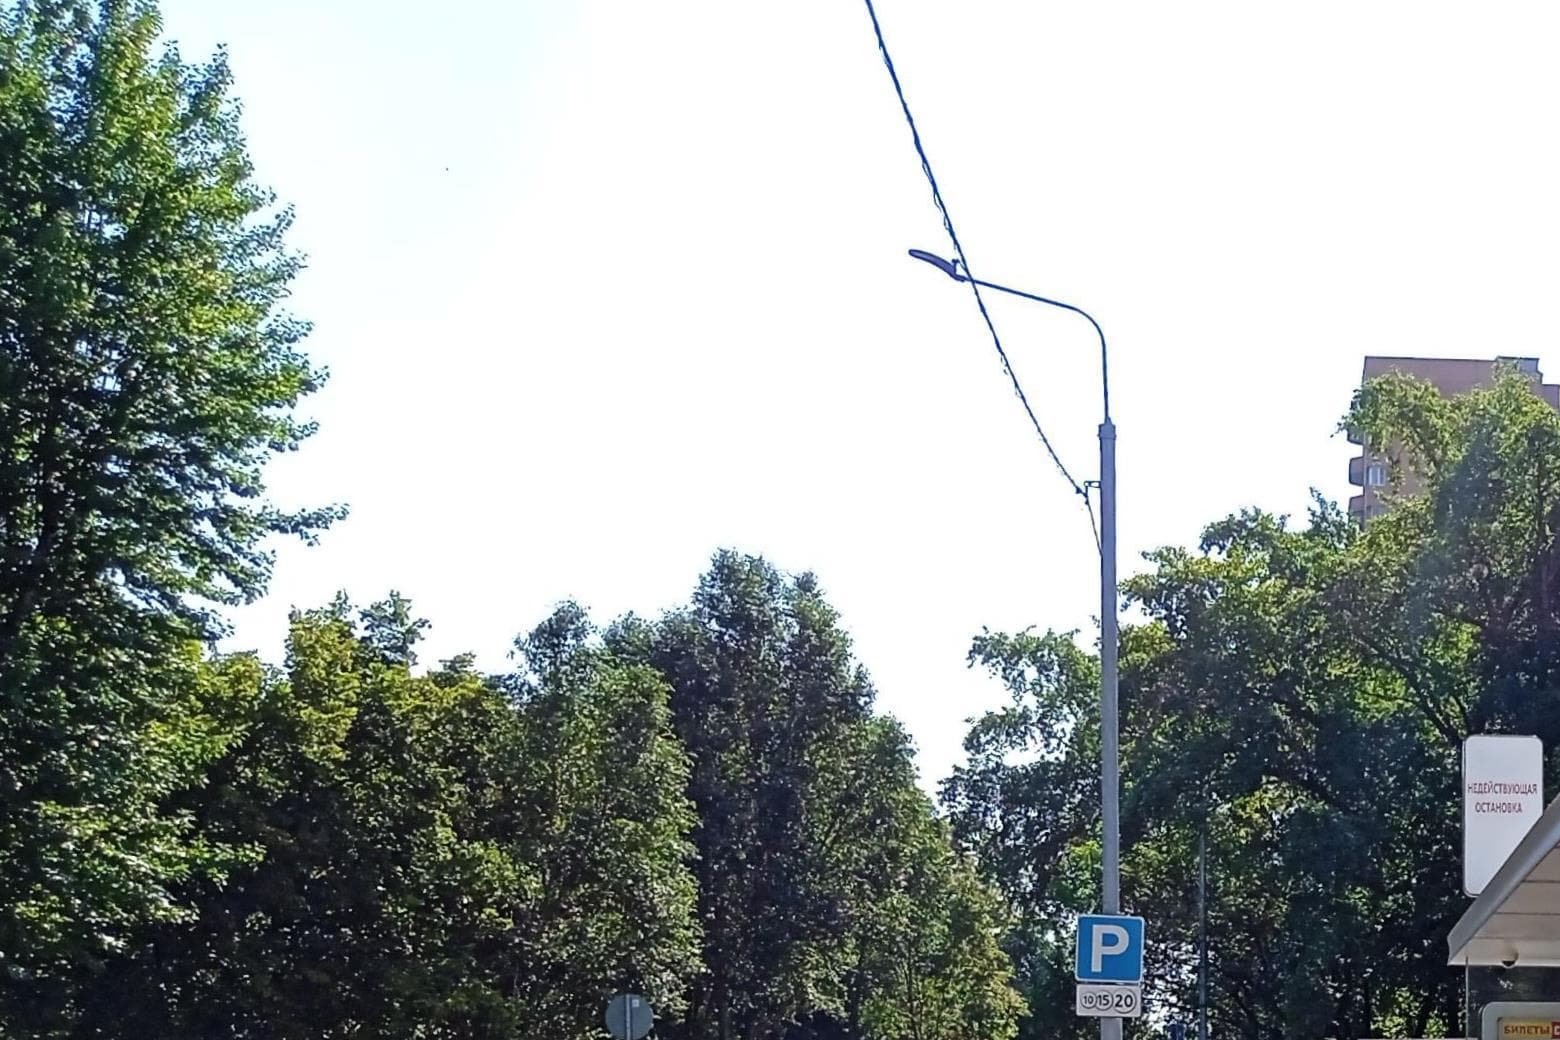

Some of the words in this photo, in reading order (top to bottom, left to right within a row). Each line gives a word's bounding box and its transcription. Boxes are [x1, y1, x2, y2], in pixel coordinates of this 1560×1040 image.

[1467, 781, 1538, 795] НЕДЕЙСТВУЮЩАЯ
[1474, 802, 1523, 814] ОСТАНОВКА
[1090, 924, 1130, 973] P
[1083, 995, 1094, 1005] 10
[1098, 994, 1110, 1006] 15
[1114, 994, 1133, 1007] 20
[1503, 1025, 1550, 1035] БИЛЕТЫ
